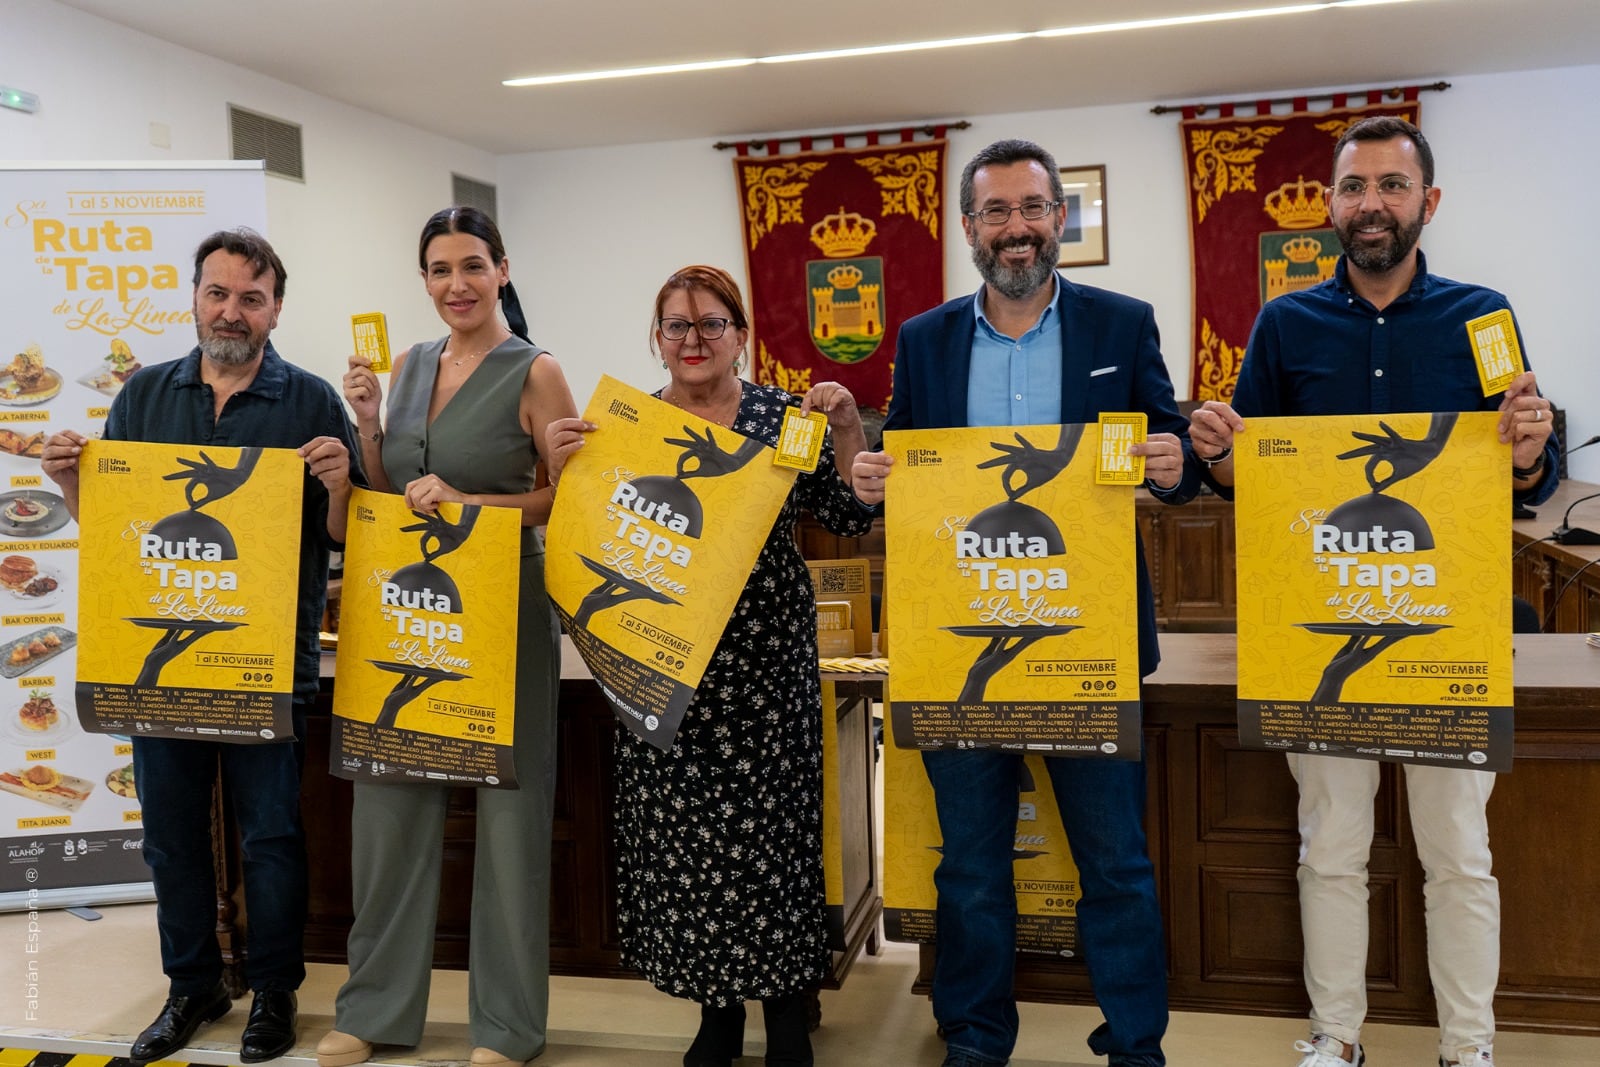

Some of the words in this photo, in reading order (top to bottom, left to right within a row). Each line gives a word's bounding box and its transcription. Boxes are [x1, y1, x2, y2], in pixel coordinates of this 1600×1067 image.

[68, 197, 74, 209] 1
[80, 197, 95, 209] al
[101, 196, 109, 208] 5
[114, 195, 206, 209] NOVIEMBRE
[33, 218, 152, 253] Ruta
[35, 256, 50, 264] de
[42, 266, 53, 275] la
[54, 257, 179, 302] Tapa
[53, 301, 71, 315] de
[65, 298, 120, 336] La
[111, 297, 195, 335] Línea
[1475, 324, 1505, 346] RUTA
[1479, 346, 1494, 363] DE
[1494, 341, 1509, 358] LA
[1484, 356, 1514, 380] TAPA
[11, 413, 46, 421] TABERNA
[90, 409, 110, 417] CAR
[622, 403, 638, 415] Una
[788, 415, 814, 432] RUTA
[1103, 423, 1133, 440] RUTA
[781, 441, 808, 459] TAPA
[1102, 440, 1116, 455] DE
[1119, 440, 1132, 455] LA
[1272, 438, 1292, 446] Una
[1102, 455, 1133, 471] TAPA
[606, 505, 617, 513] de
[610, 480, 690, 536] Ruta
[607, 513, 615, 521] la
[0, 543, 30, 551] CARLOS
[600, 541, 612, 552] de
[615, 511, 693, 568] Tapa
[956, 530, 1049, 560] Ruta
[1313, 524, 1415, 554] Ruta
[140, 534, 222, 562] Ruta
[603, 541, 635, 580] La
[956, 560, 969, 569] de
[1313, 555, 1327, 564] de
[144, 567, 152, 575] la
[630, 558, 689, 595] Línea
[962, 569, 971, 577] la
[1319, 564, 1329, 573] la
[1329, 557, 1436, 597] Tapa
[152, 562, 237, 597] Tapa
[971, 562, 1068, 600] Tapa
[381, 581, 451, 614] Ruta
[149, 592, 162, 604] de
[157, 593, 192, 621] La
[188, 594, 248, 623] Línea
[969, 597, 985, 610] de
[978, 595, 1021, 627] La
[1014, 595, 1083, 627] Línea
[1326, 593, 1343, 607] de
[1336, 592, 1383, 625] La
[1376, 592, 1454, 625] Línea
[391, 609, 463, 647] Tapa
[619, 614, 625, 623] 1
[626, 617, 635, 627] al
[635, 622, 641, 631] 5
[642, 626, 693, 655] NOVIEMBRE
[203, 655, 211, 663] al
[222, 656, 274, 665] NOVIEMBRE
[388, 639, 400, 649] de
[395, 640, 427, 668] La
[424, 643, 473, 672] Línea
[1026, 664, 1030, 673] 1
[1034, 663, 1045, 673] al
[1047, 664, 1053, 672] 5
[1056, 663, 1116, 673] NOVIEMBRE
[1388, 664, 1392, 673] 1
[1397, 665, 1407, 673] al
[1411, 665, 1417, 673] 5
[1421, 665, 1488, 674] NOVIEMBRE
[22, 679, 52, 687] BARBAS
[434, 702, 441, 710] al
[443, 703, 448, 712] 5
[450, 705, 496, 719] NOVIEMBRE
[1024, 882, 1075, 892] NOVIEMBRE
